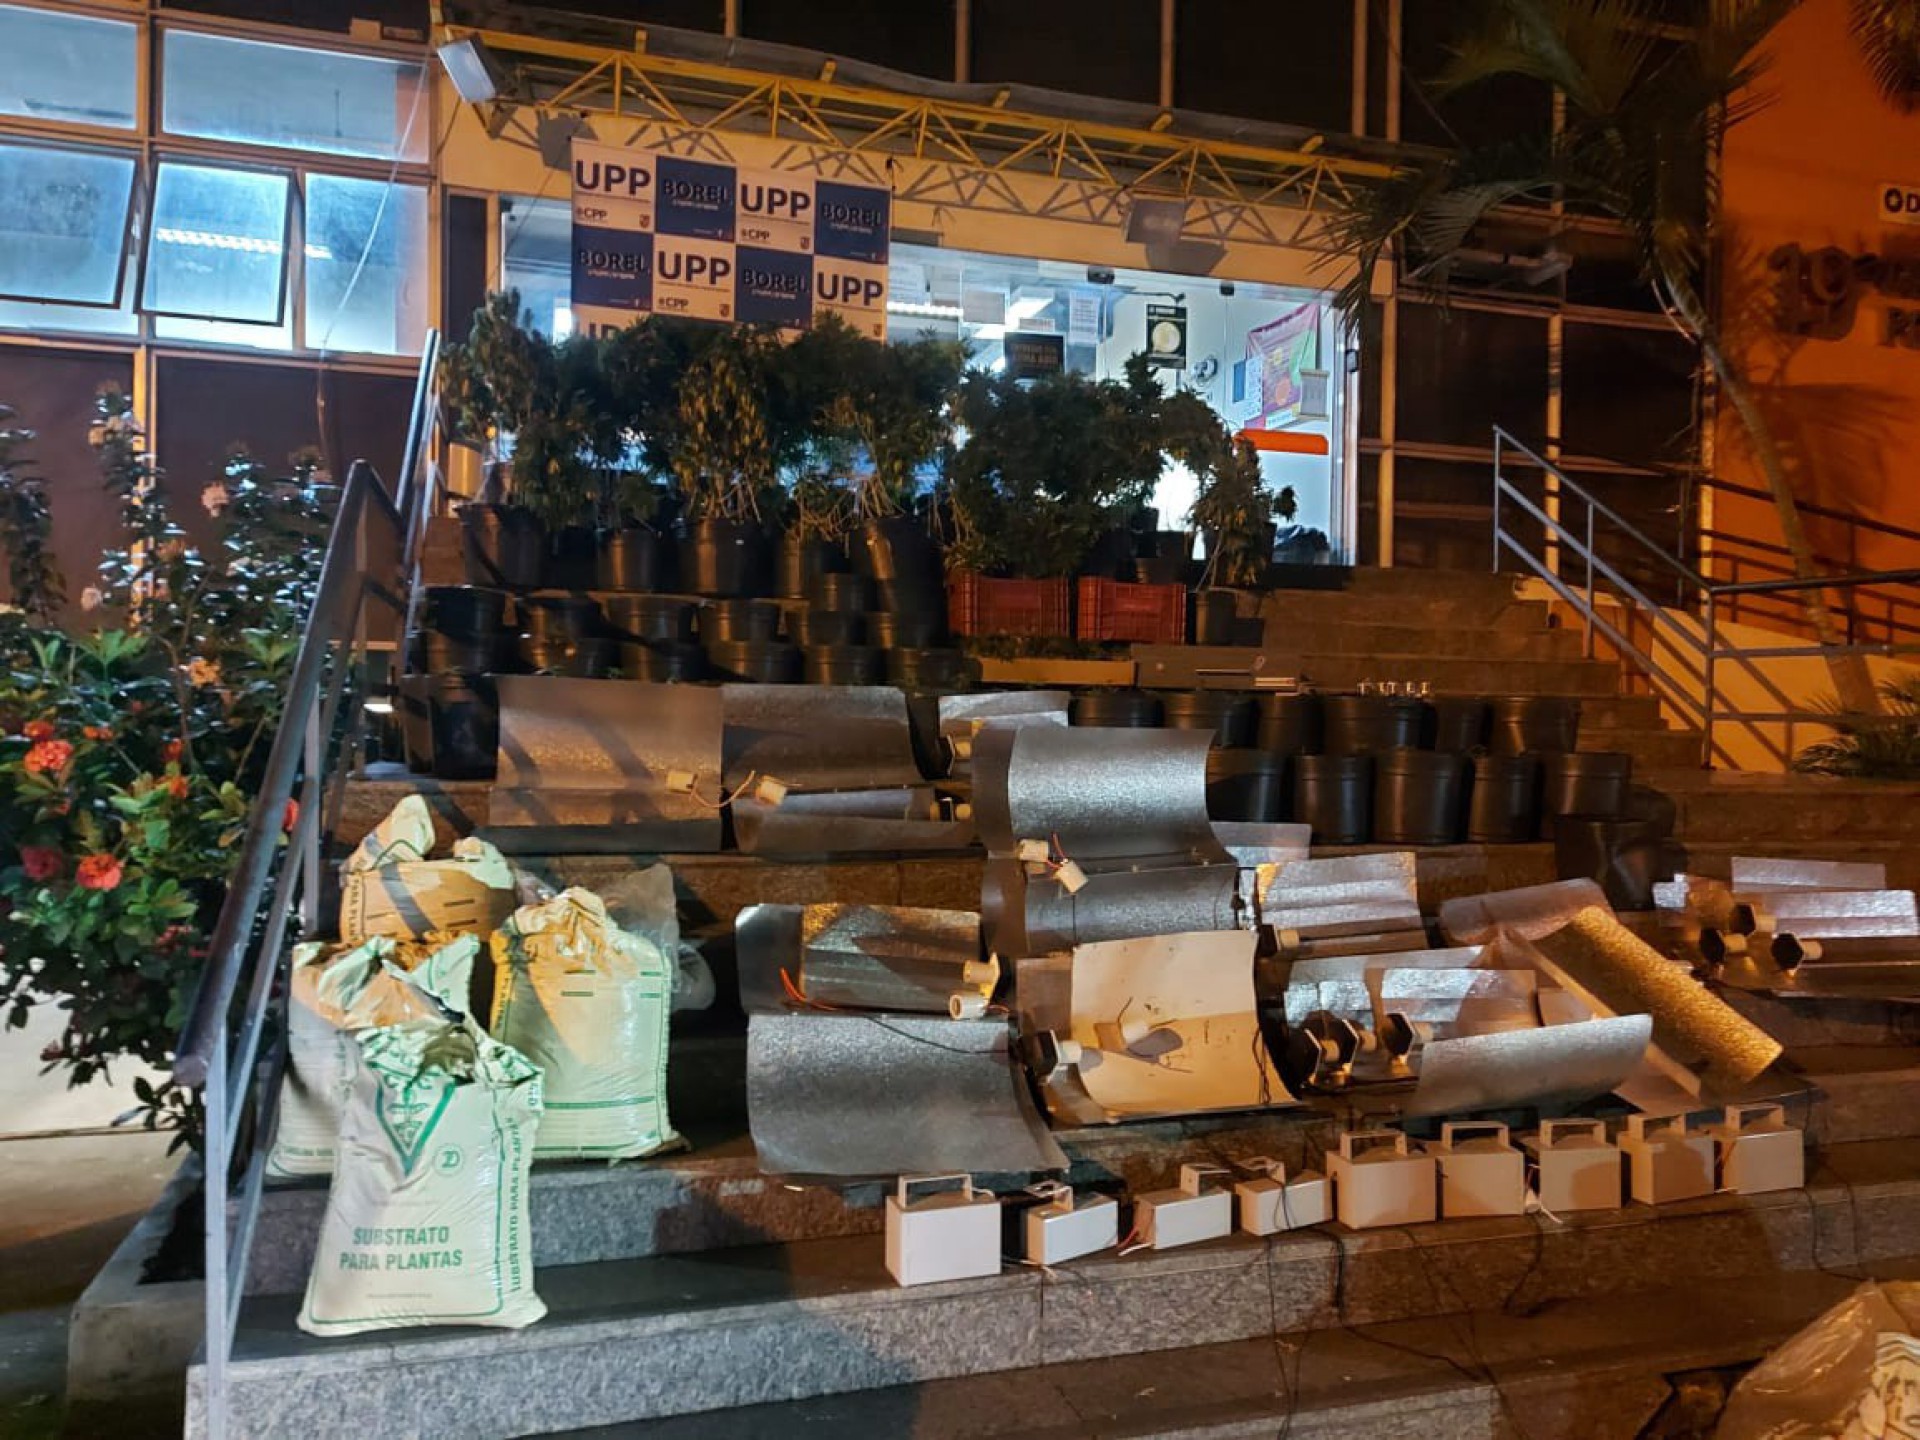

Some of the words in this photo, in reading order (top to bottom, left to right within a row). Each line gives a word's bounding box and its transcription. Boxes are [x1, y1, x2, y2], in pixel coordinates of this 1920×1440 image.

[575, 160, 651, 195] UPP
[740, 183, 811, 218] UPP
[658, 250, 731, 285] UPP
[817, 271, 883, 306] UPP
[353, 1226, 450, 1245] SUBSTRATO
[340, 1252, 380, 1270] PARA
[385, 1249, 463, 1270] PLANTAS
